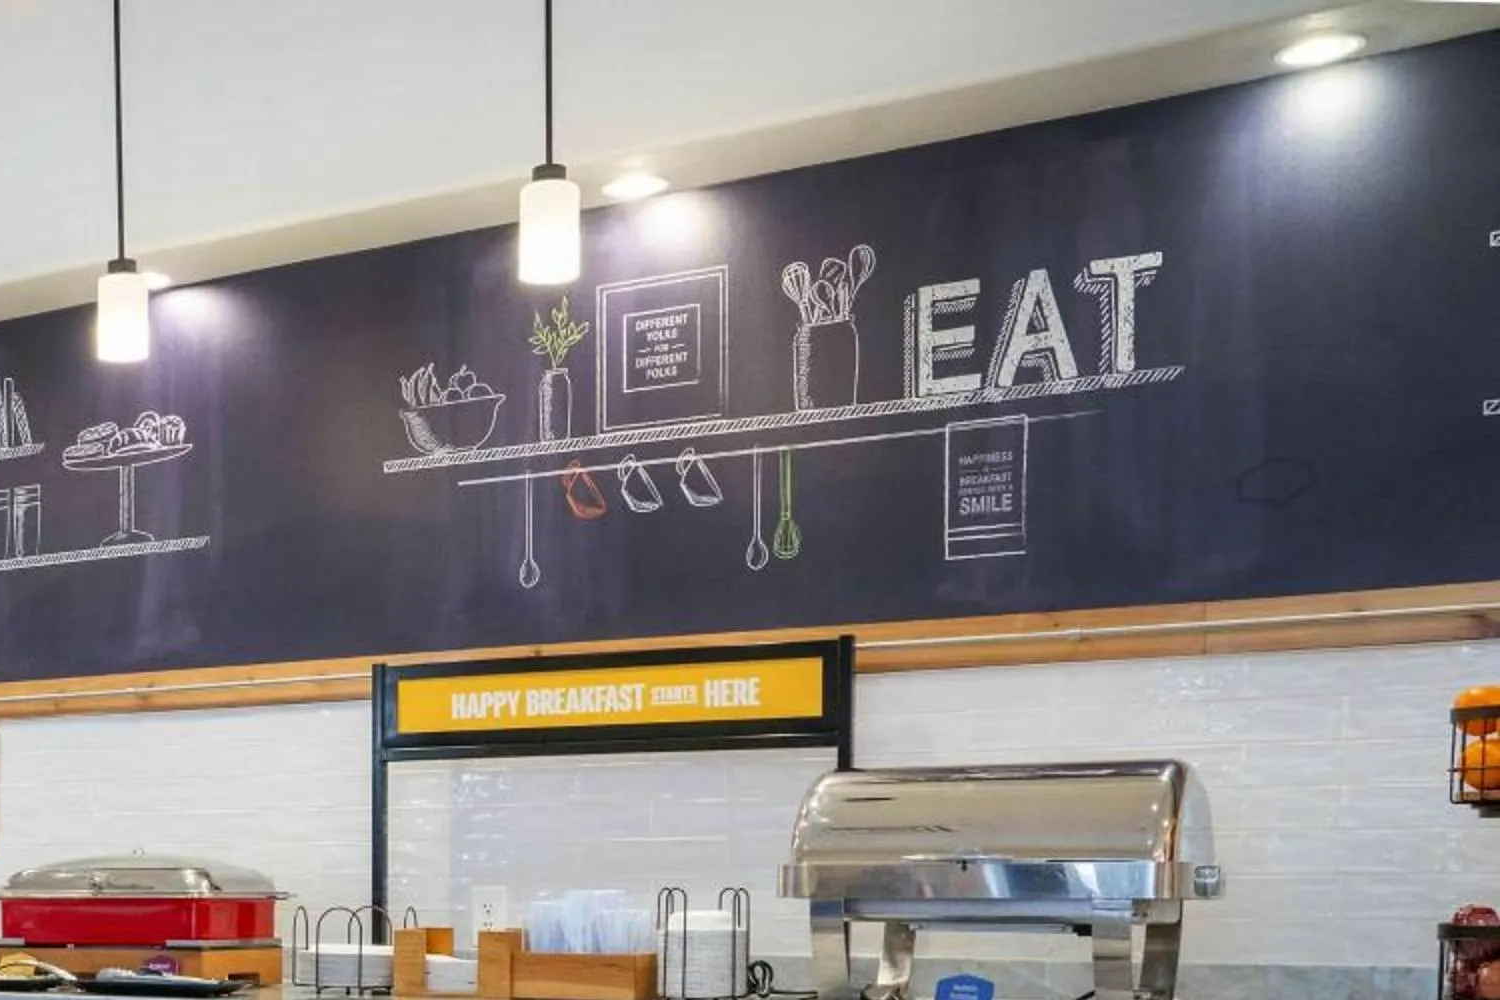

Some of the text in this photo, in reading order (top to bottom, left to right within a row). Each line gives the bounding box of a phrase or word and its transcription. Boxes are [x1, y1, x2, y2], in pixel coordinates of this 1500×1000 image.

[635, 313, 688, 332] DIFFERENT
[903, 251, 1163, 398] EAT
[635, 351, 688, 369] DIFFERENT
[959, 493, 1013, 516] SMILE
[451, 690, 521, 720] HAPPY
[526, 683, 645, 716] BREAKFAST
[705, 676, 761, 708] HERE
